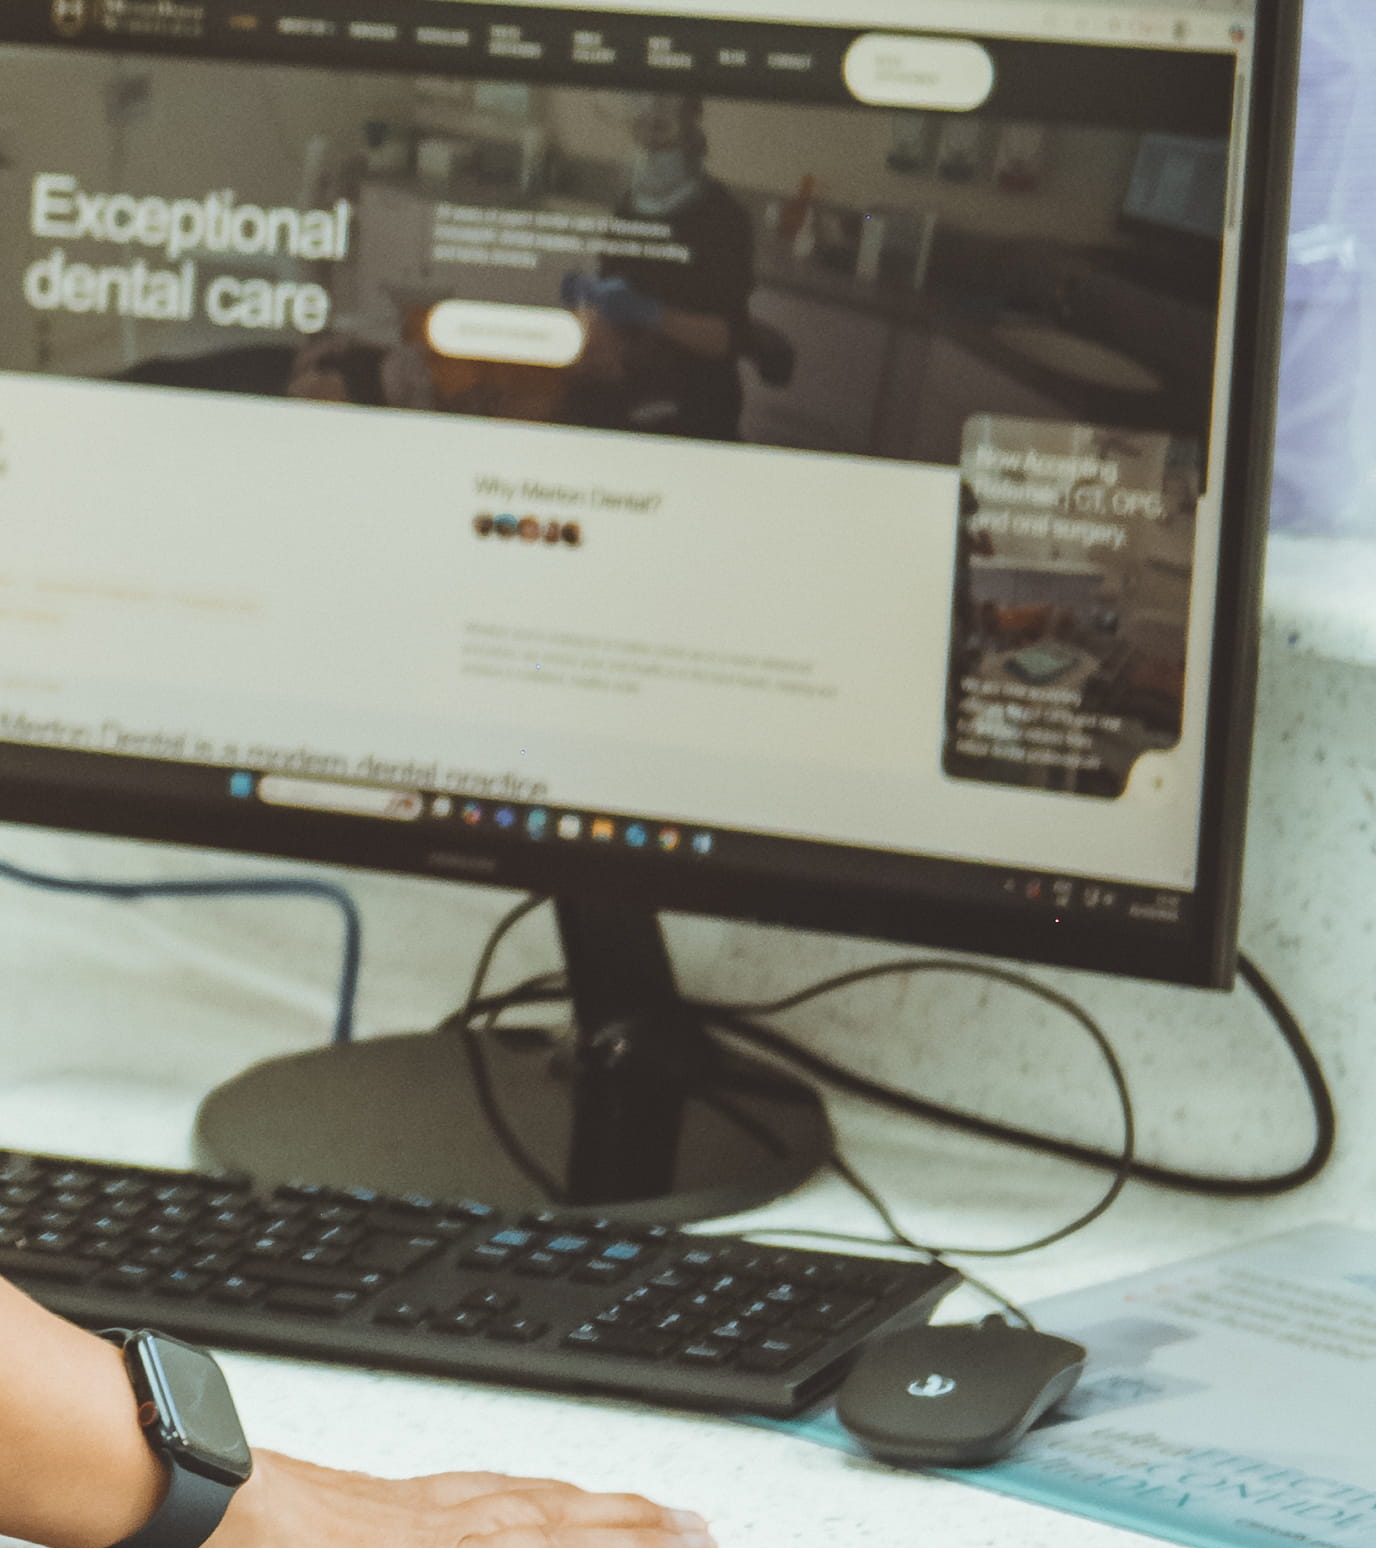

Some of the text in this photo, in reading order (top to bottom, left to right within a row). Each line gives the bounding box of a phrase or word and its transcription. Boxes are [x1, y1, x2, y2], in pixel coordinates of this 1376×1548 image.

[32, 172, 349, 261] Exceptional
[24, 250, 331, 334] dental care
[475, 473, 516, 503] Why
